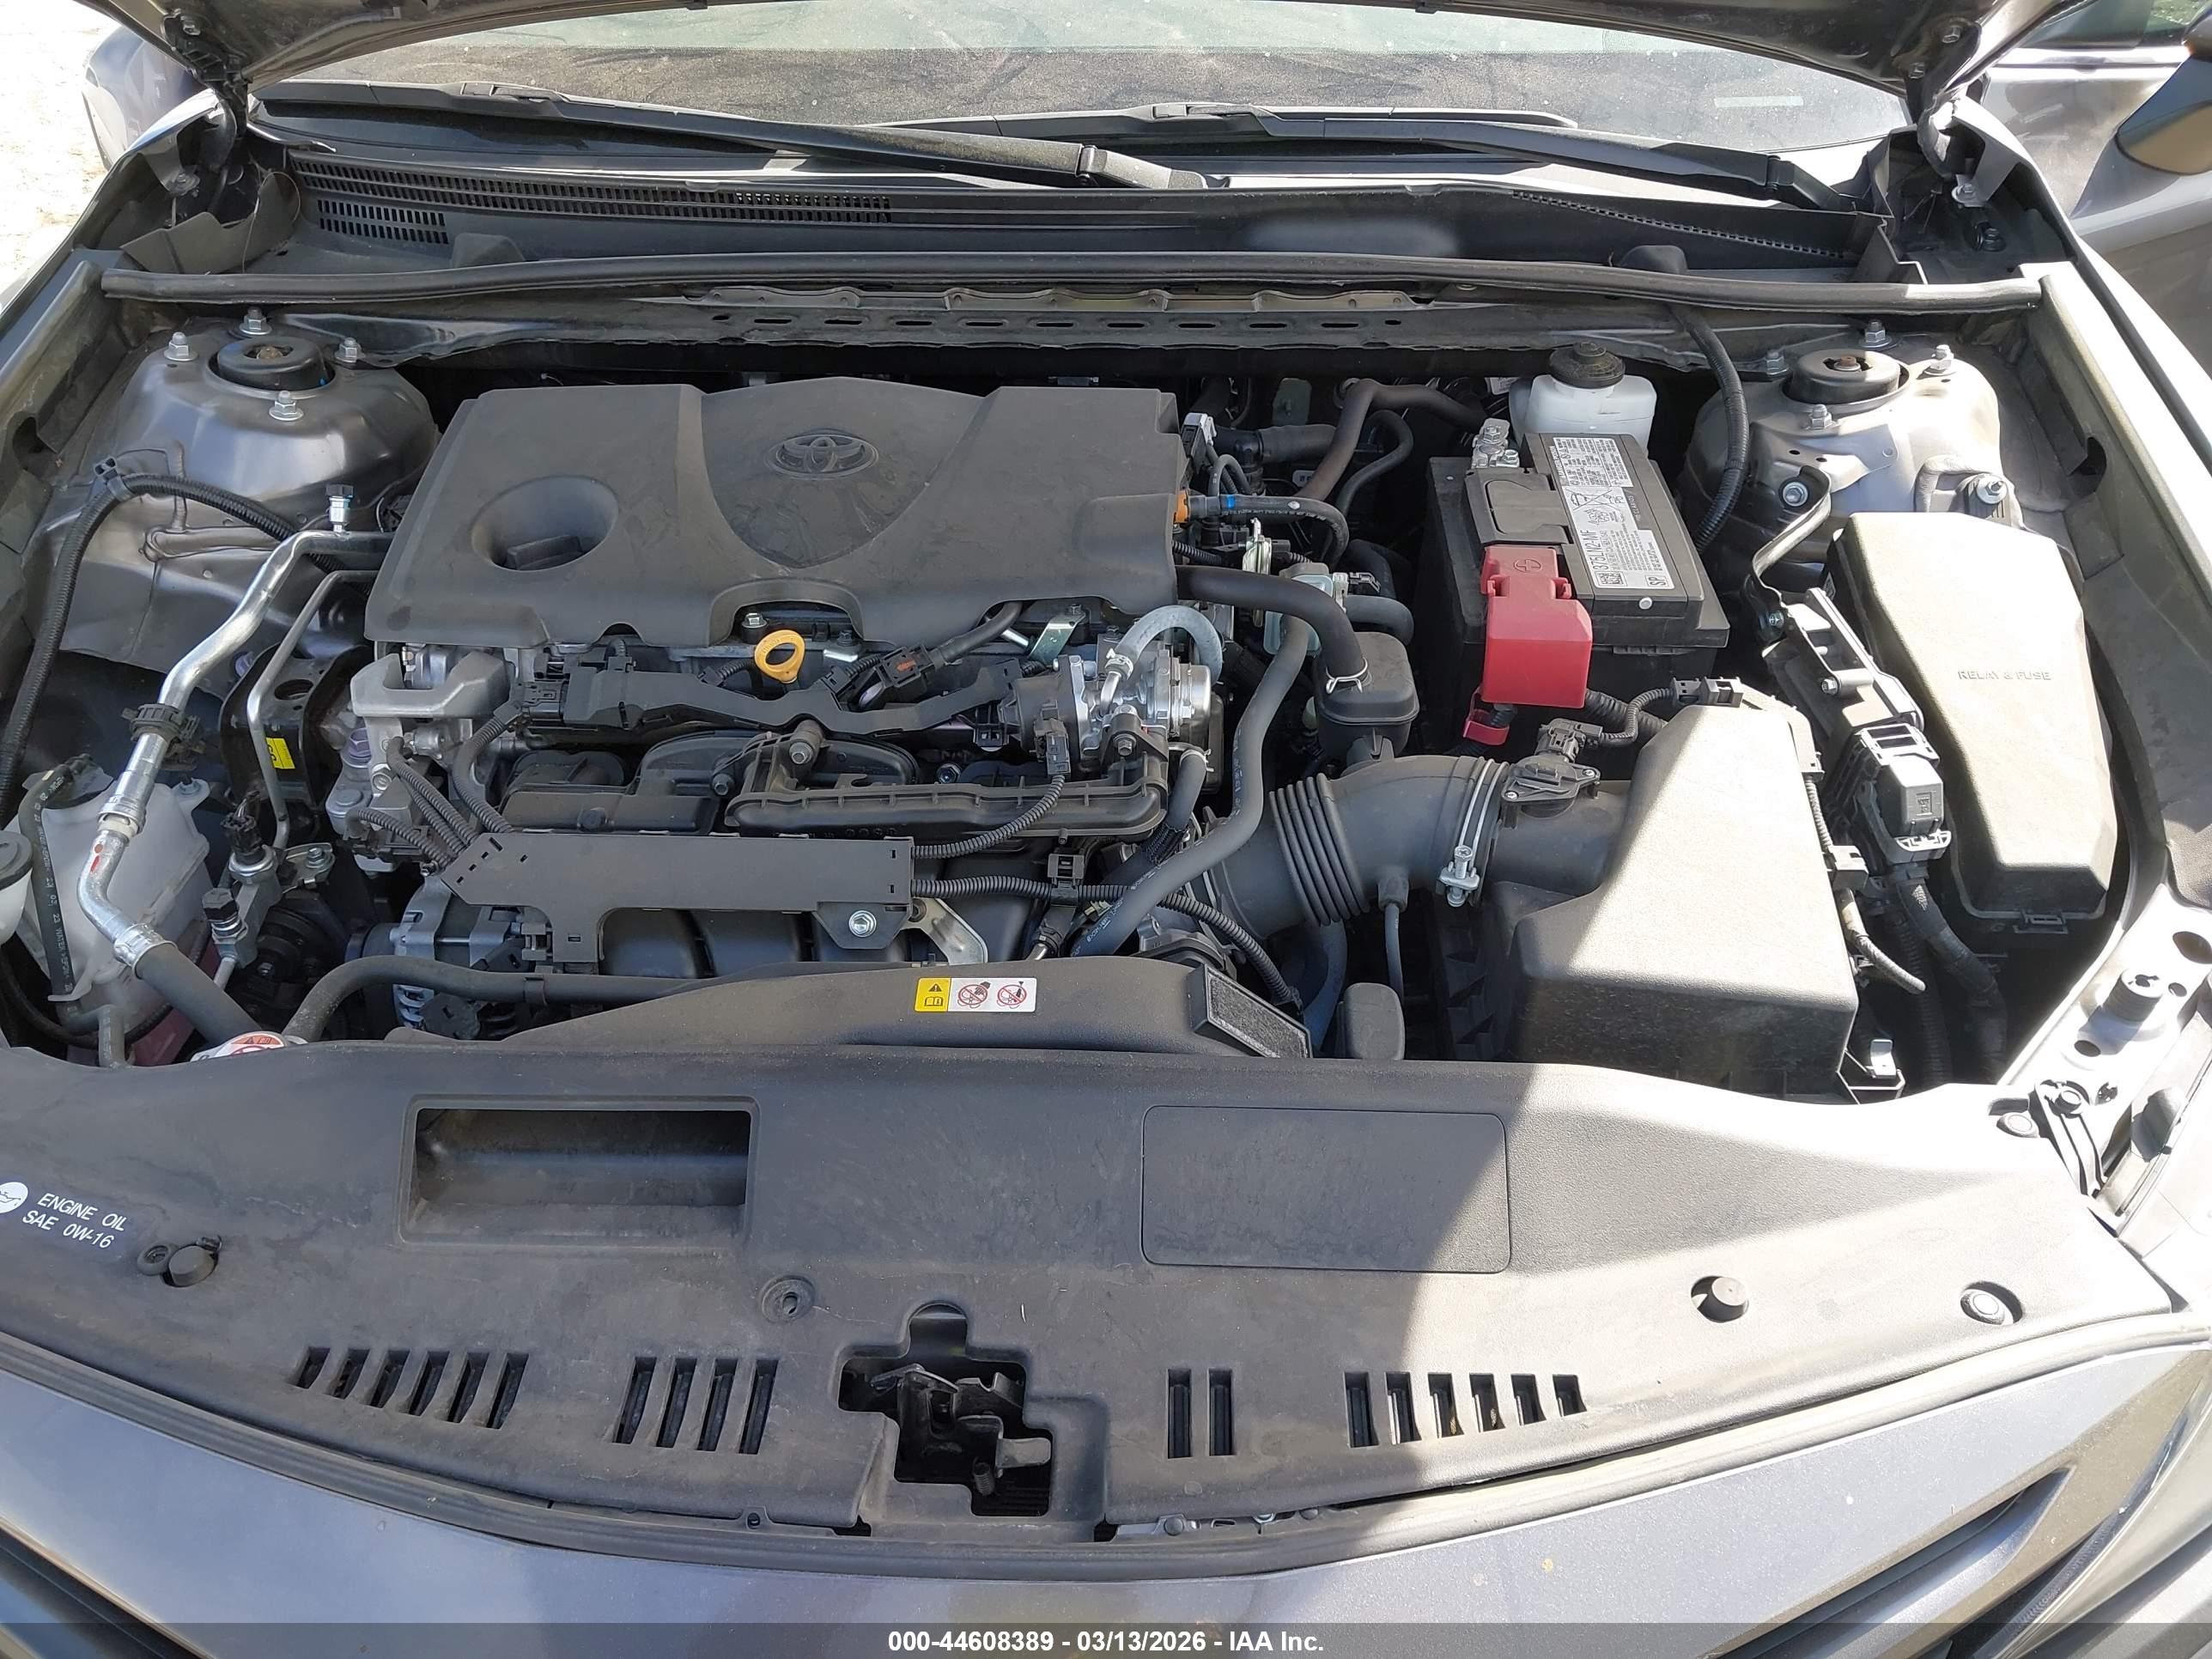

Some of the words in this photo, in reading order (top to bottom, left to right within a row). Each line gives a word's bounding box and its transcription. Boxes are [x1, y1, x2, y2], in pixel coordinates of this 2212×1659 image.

[1580, 530, 1608, 570] 375LN2-MF
[1648, 576, 1667, 586] SP
[1958, 670, 2000, 680] RELAY
[2016, 671, 2052, 681] FUSE
[22, 1210, 59, 1231] SAE
[63, 1223, 115, 1249] 0W-16
[37, 1193, 99, 1220] ENGINE
[101, 1212, 129, 1232] OIL
